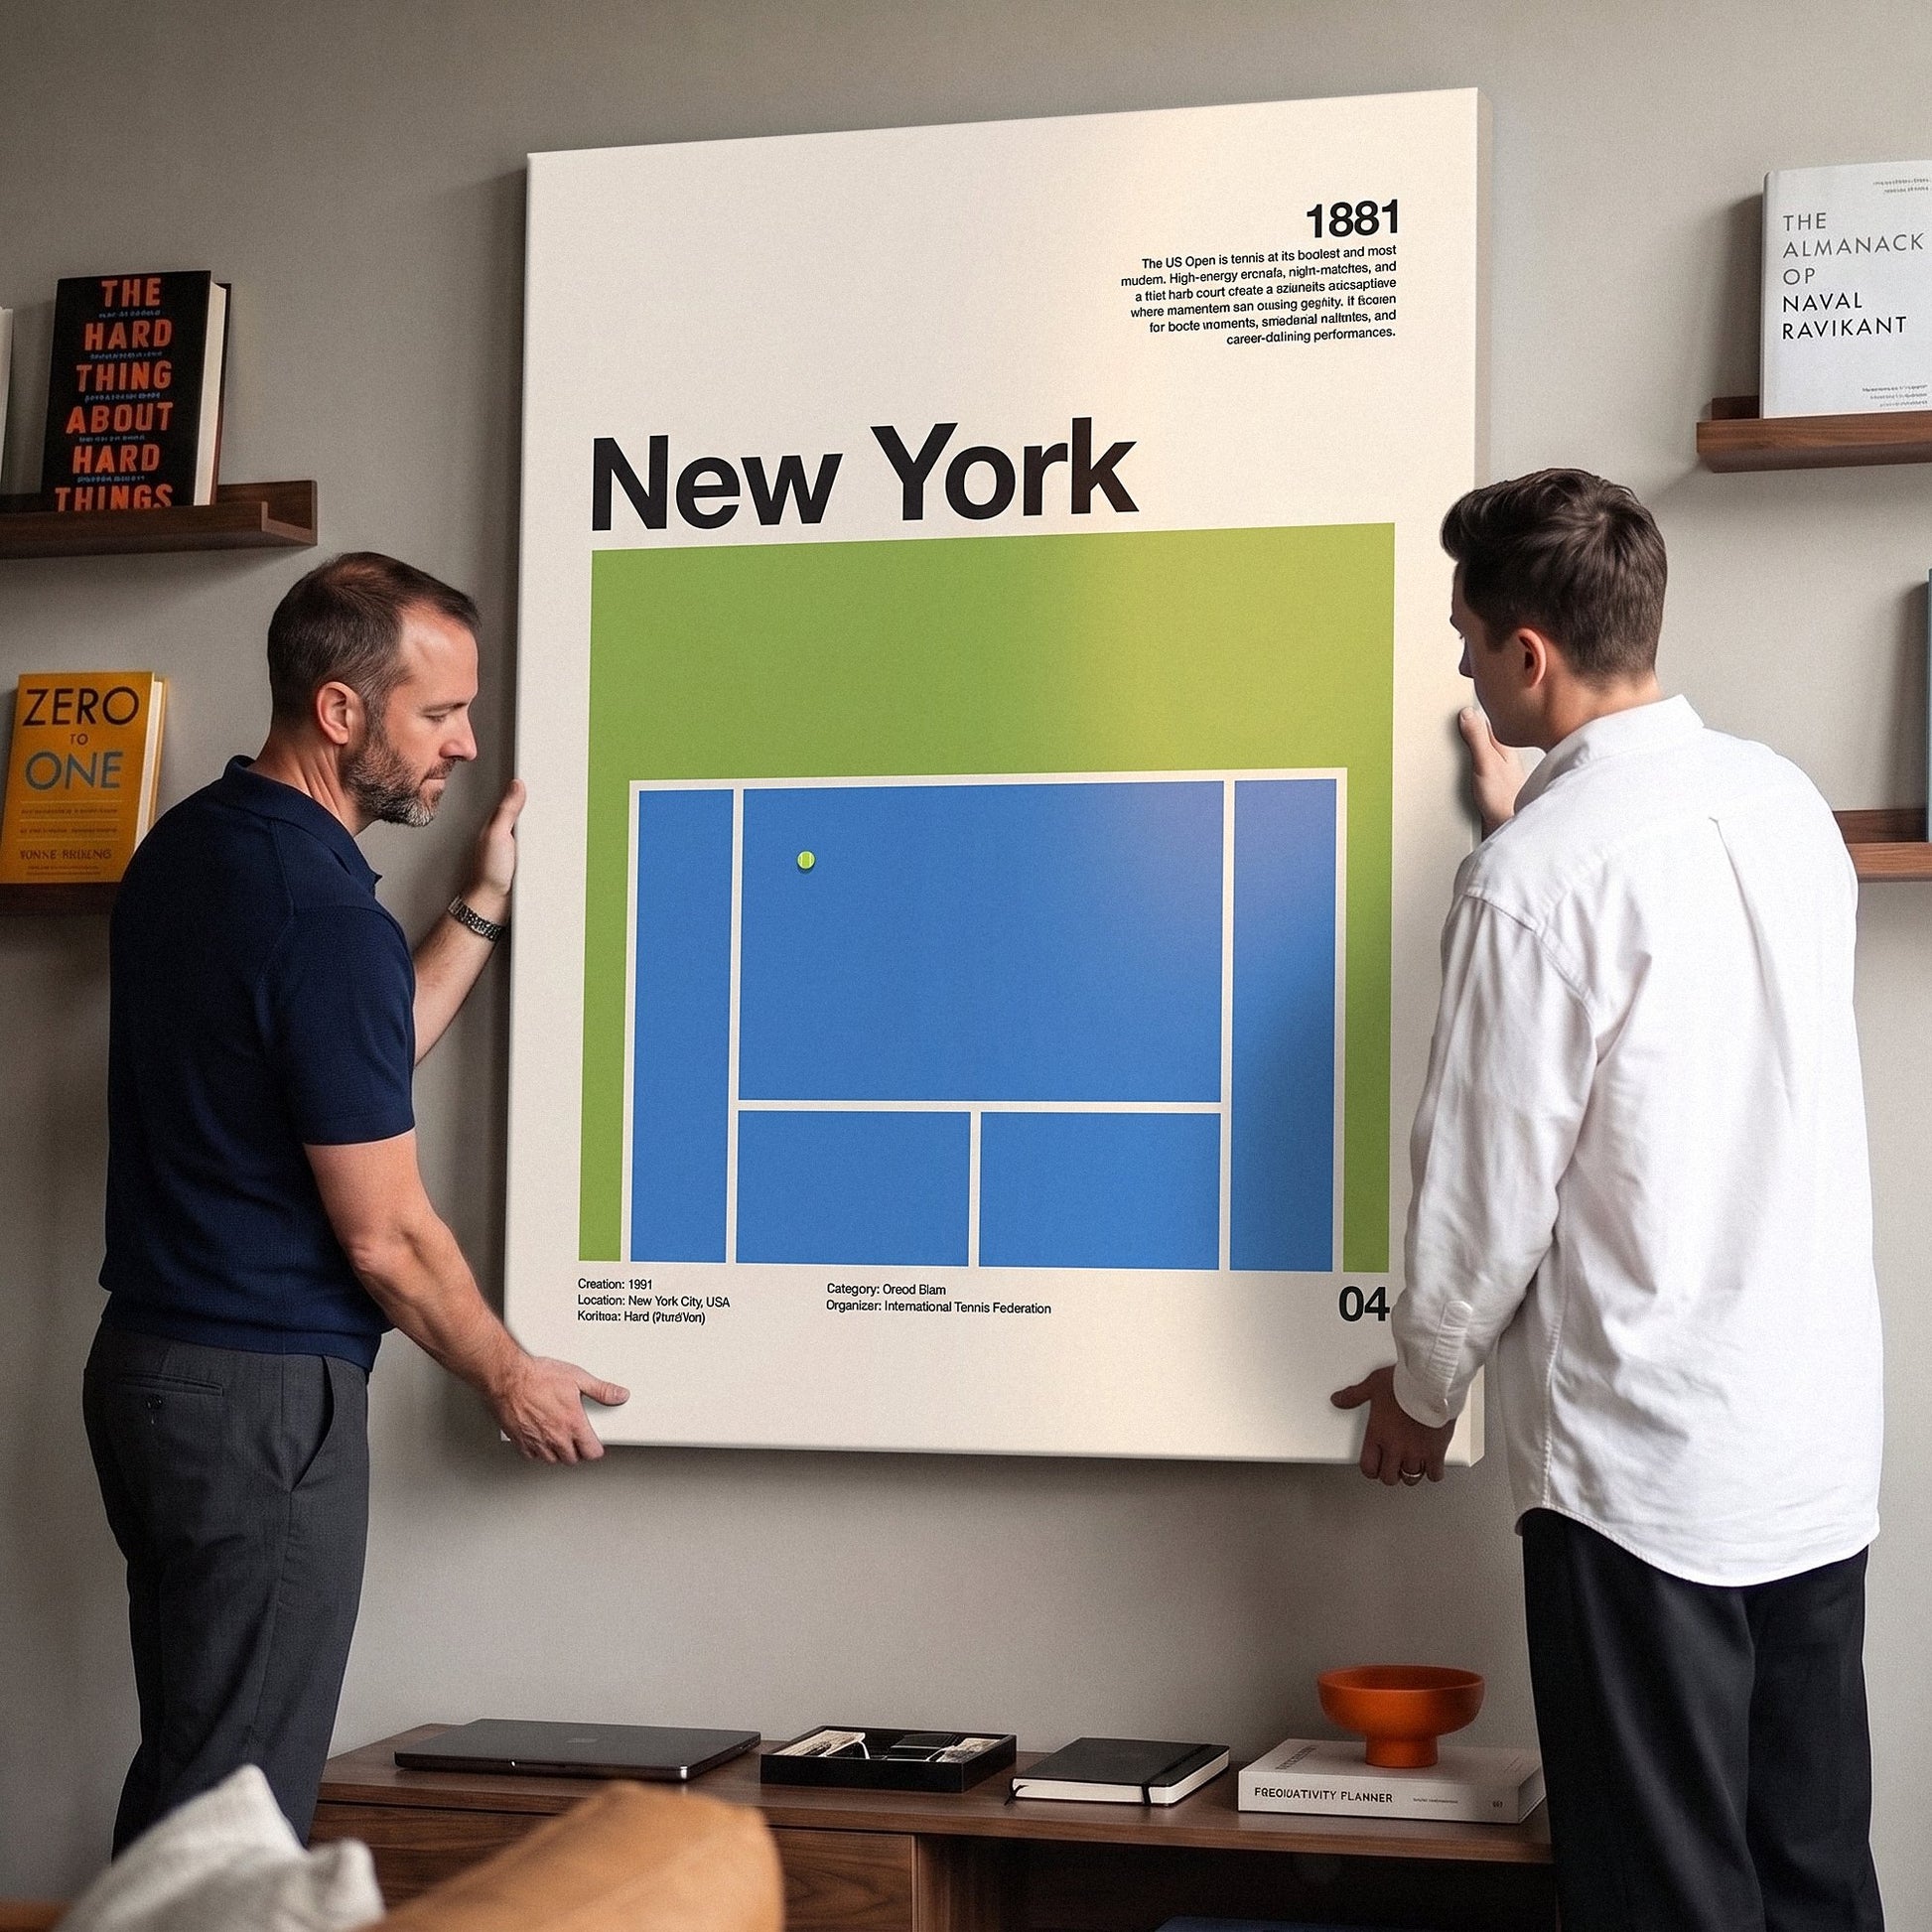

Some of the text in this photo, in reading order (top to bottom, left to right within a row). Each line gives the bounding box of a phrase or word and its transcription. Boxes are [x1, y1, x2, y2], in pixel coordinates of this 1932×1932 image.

[1307, 199, 1399, 238] 1881
[1783, 211, 1827, 231] THE
[1142, 258, 1163, 269] The
[1166, 256, 1182, 268] US
[1185, 255, 1216, 269] Open
[1218, 254, 1228, 265] is
[1231, 252, 1265, 264] tennis
[1268, 252, 1279, 262] at
[1281, 251, 1295, 261] its
[1343, 246, 1365, 258] and
[1368, 245, 1397, 257] most
[1783, 232, 1925, 258] ALMANACK
[1170, 271, 1238, 285] High-energy
[1374, 261, 1397, 273] and
[1783, 268, 1816, 286] OP
[101, 277, 162, 308] THE
[1169, 289, 1193, 300] harb
[1196, 287, 1225, 298] court
[1783, 292, 1863, 313] NAVAL
[1131, 307, 1165, 318] where
[1168, 304, 1231, 316] mamentem
[1233, 303, 1254, 313] san
[1150, 323, 1166, 333] for
[1374, 310, 1397, 321] and
[84, 319, 173, 351] HARD
[1313, 328, 1396, 343] performances.
[1782, 316, 1907, 340] RAVIKANT
[76, 360, 172, 393] THING
[66, 401, 174, 435] ABOUT
[71, 443, 161, 475] HARD
[592, 416, 1140, 532] New York
[55, 483, 174, 512] THINGS
[22, 686, 140, 727] ZERO
[69, 733, 88, 746] TO
[25, 751, 124, 790] ONE
[578, 1278, 652, 1290] Creation: 1991
[827, 1283, 946, 1297] Category: Oreod Blam
[578, 1294, 731, 1310] Location: New York City, USA
[826, 1300, 1051, 1314] Organizer: International Tennis Federation
[1339, 1286, 1390, 1321] 04
[623, 1311, 649, 1322] Hard
